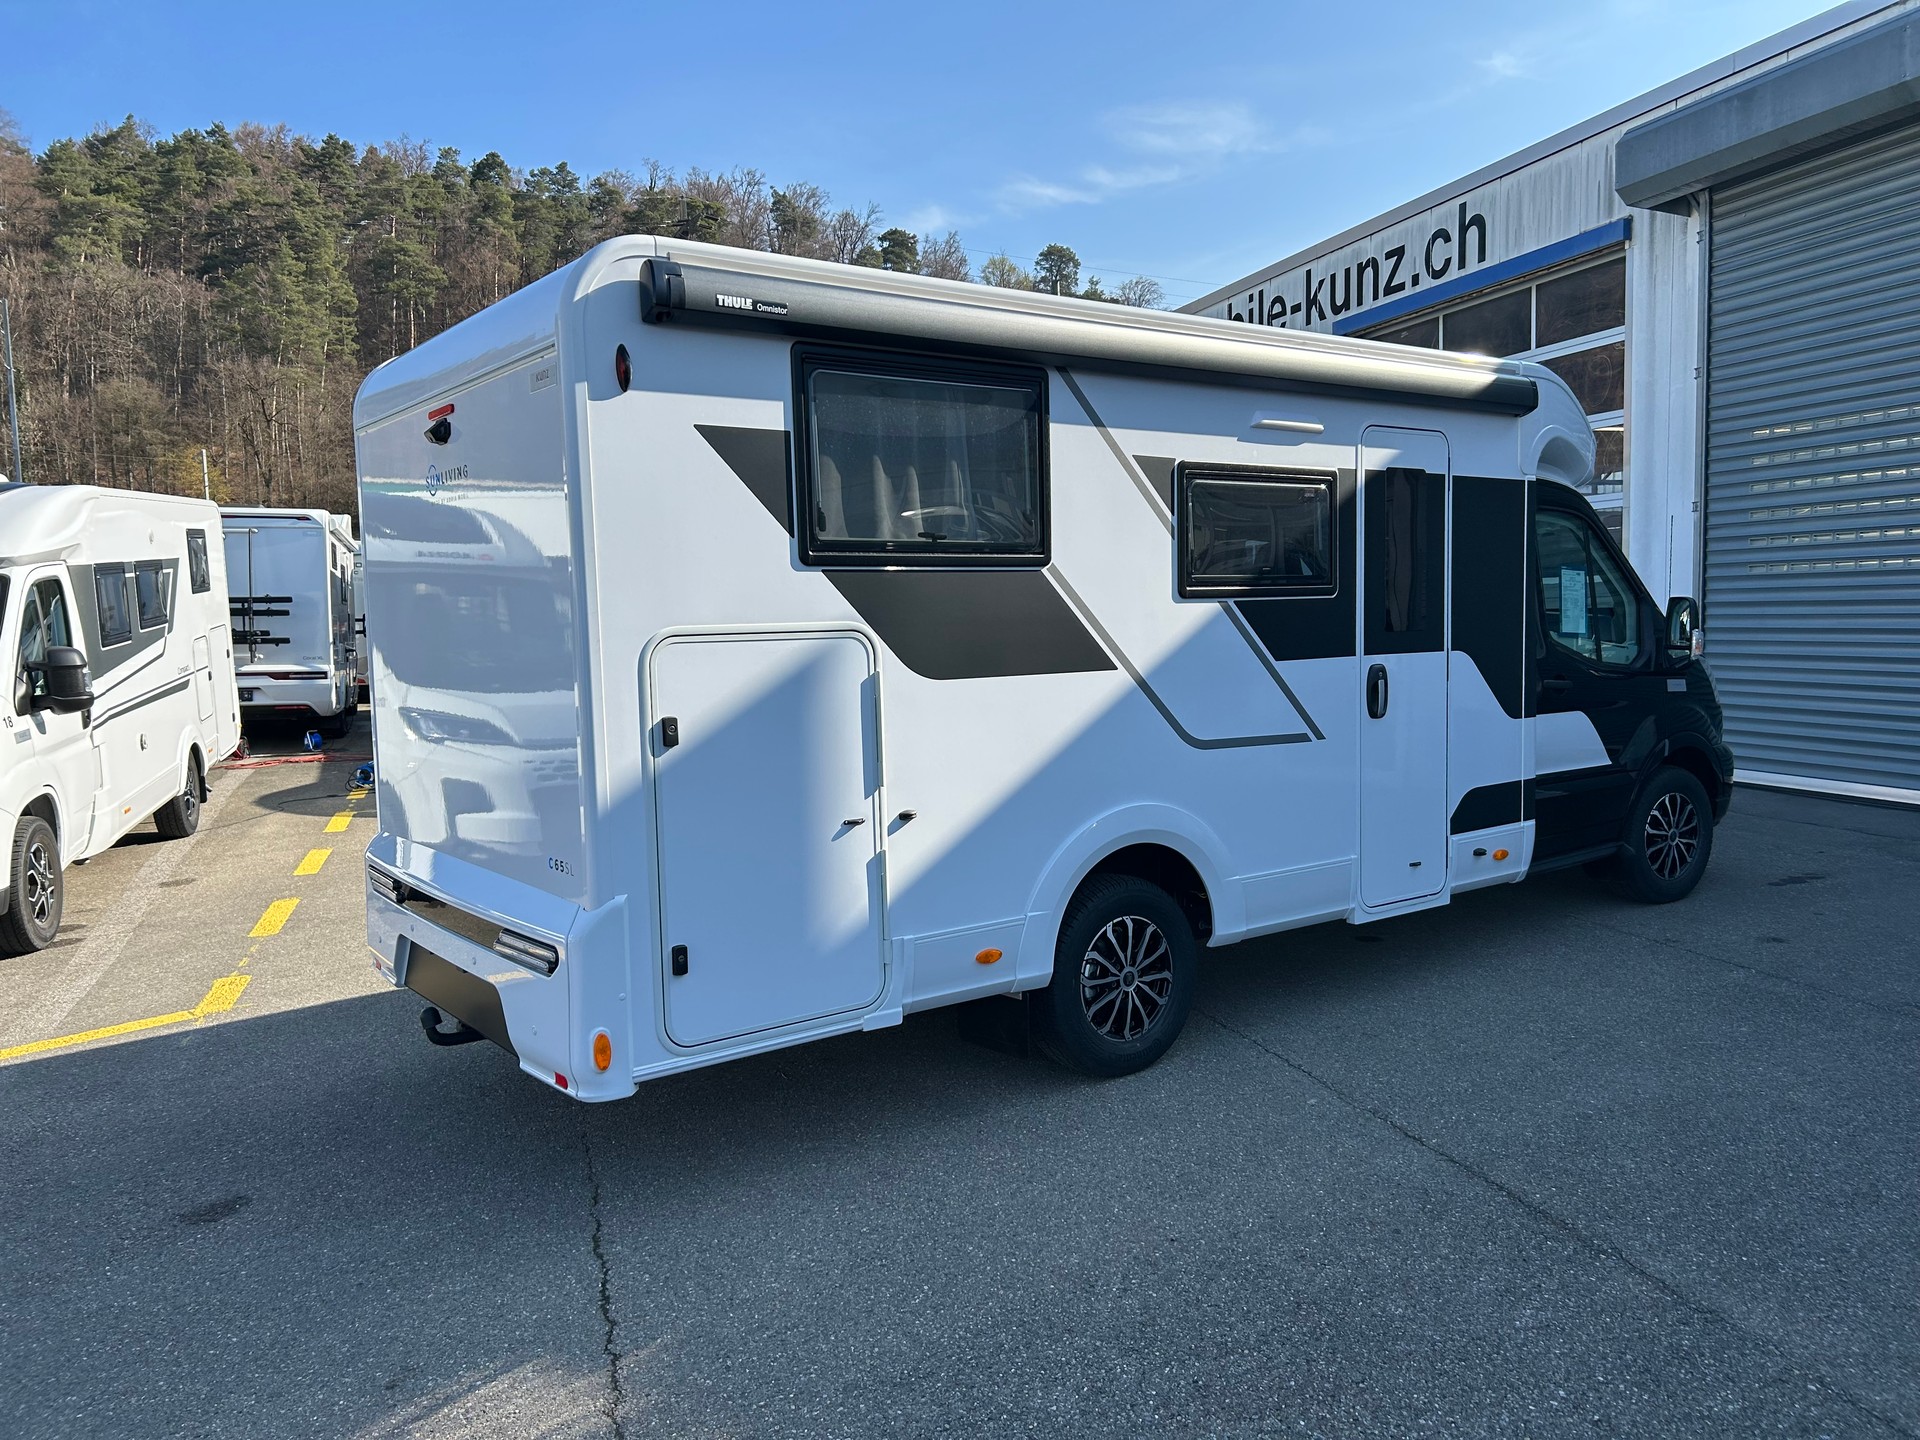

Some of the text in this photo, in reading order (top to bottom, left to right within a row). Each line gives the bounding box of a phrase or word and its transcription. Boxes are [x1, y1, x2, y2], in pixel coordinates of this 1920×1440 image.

[716, 294, 788, 315] THULE Omnistor
[425, 464, 469, 489] SUNLIVING
[3, 715, 14, 729] 18
